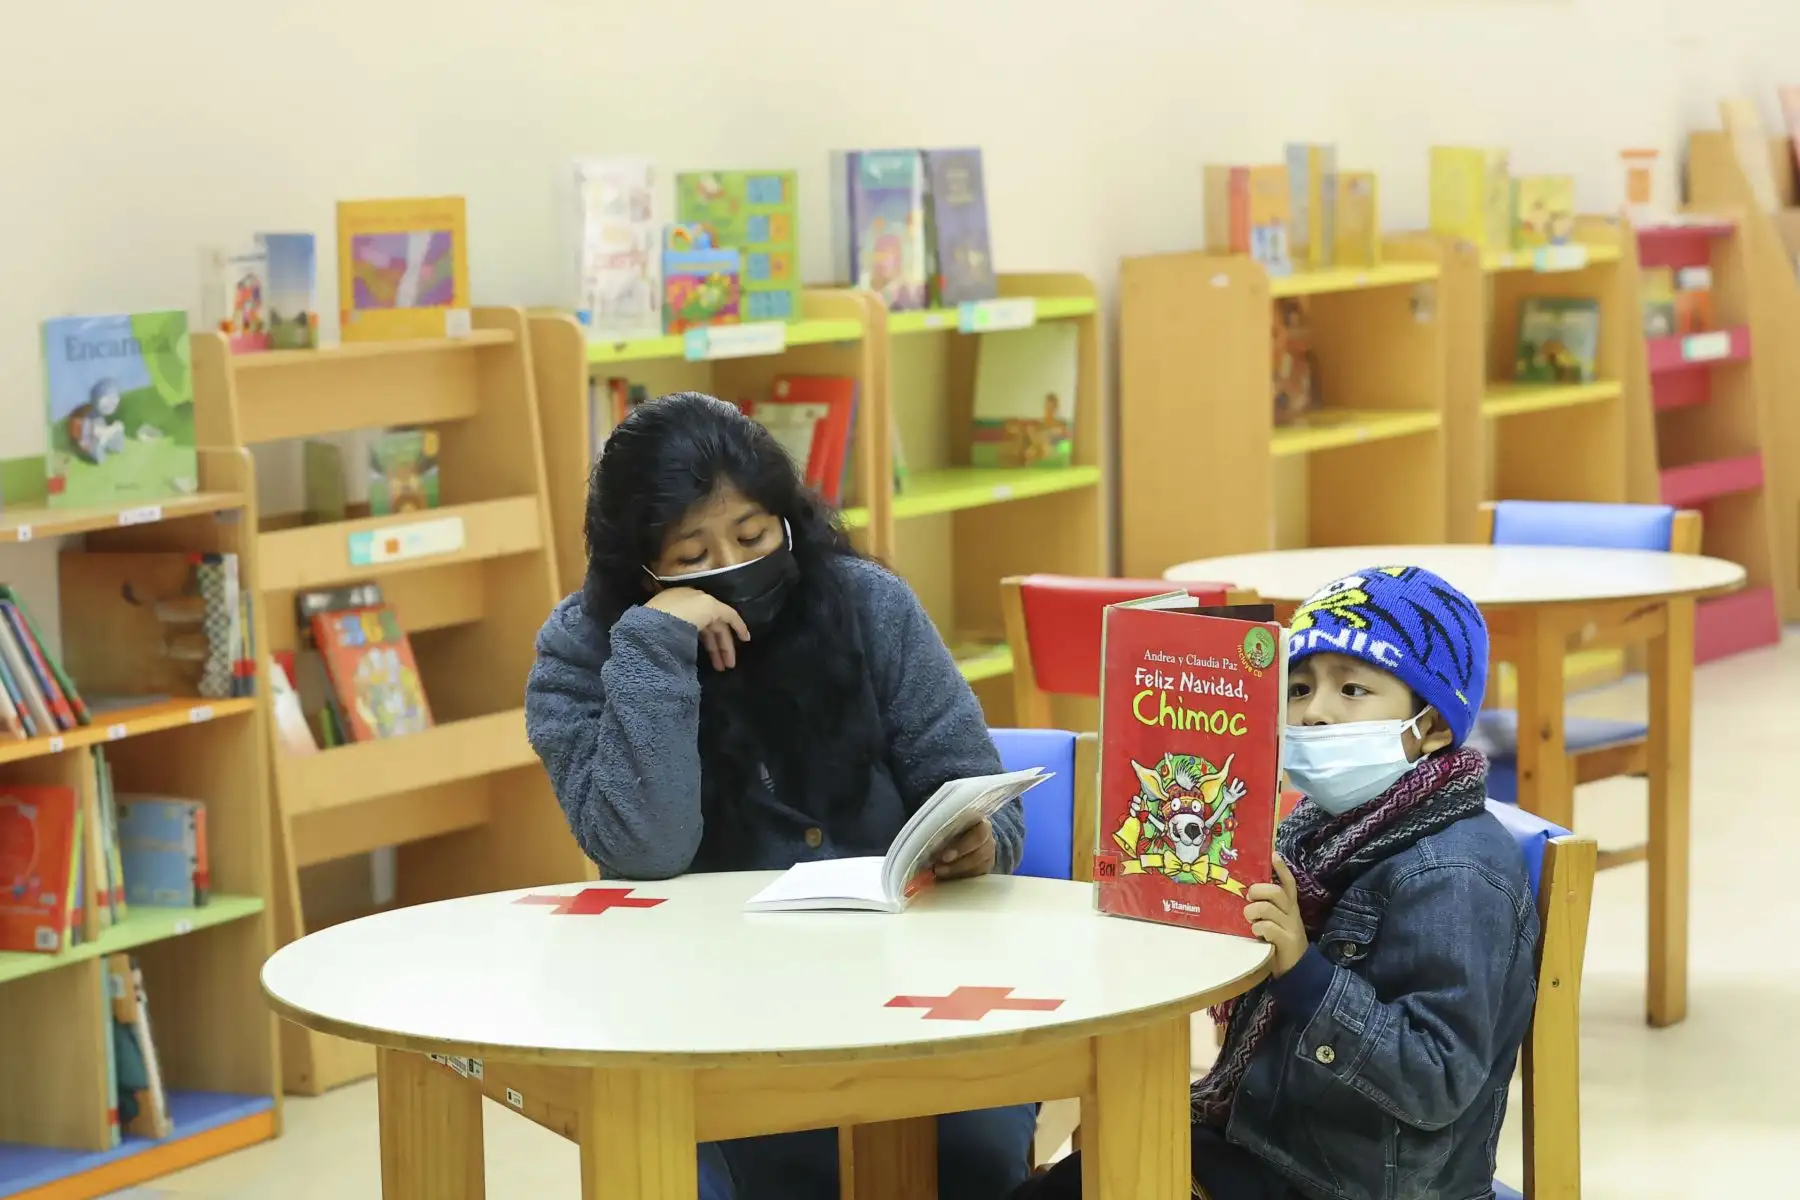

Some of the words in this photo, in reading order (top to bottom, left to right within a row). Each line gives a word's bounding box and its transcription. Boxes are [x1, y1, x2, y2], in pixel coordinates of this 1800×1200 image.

[1144, 649, 1176, 664] Andrea
[1178, 655, 1184, 667] y
[1186, 654, 1220, 669] Claudia
[1222, 658, 1239, 671] Paz
[1135, 667, 1175, 690] Feliz
[1180, 672, 1249, 702] Navidad,
[1253, 669, 1263, 678] CD
[1132, 689, 1248, 736] Chimoc
[1170, 900, 1201, 913] Titanium
